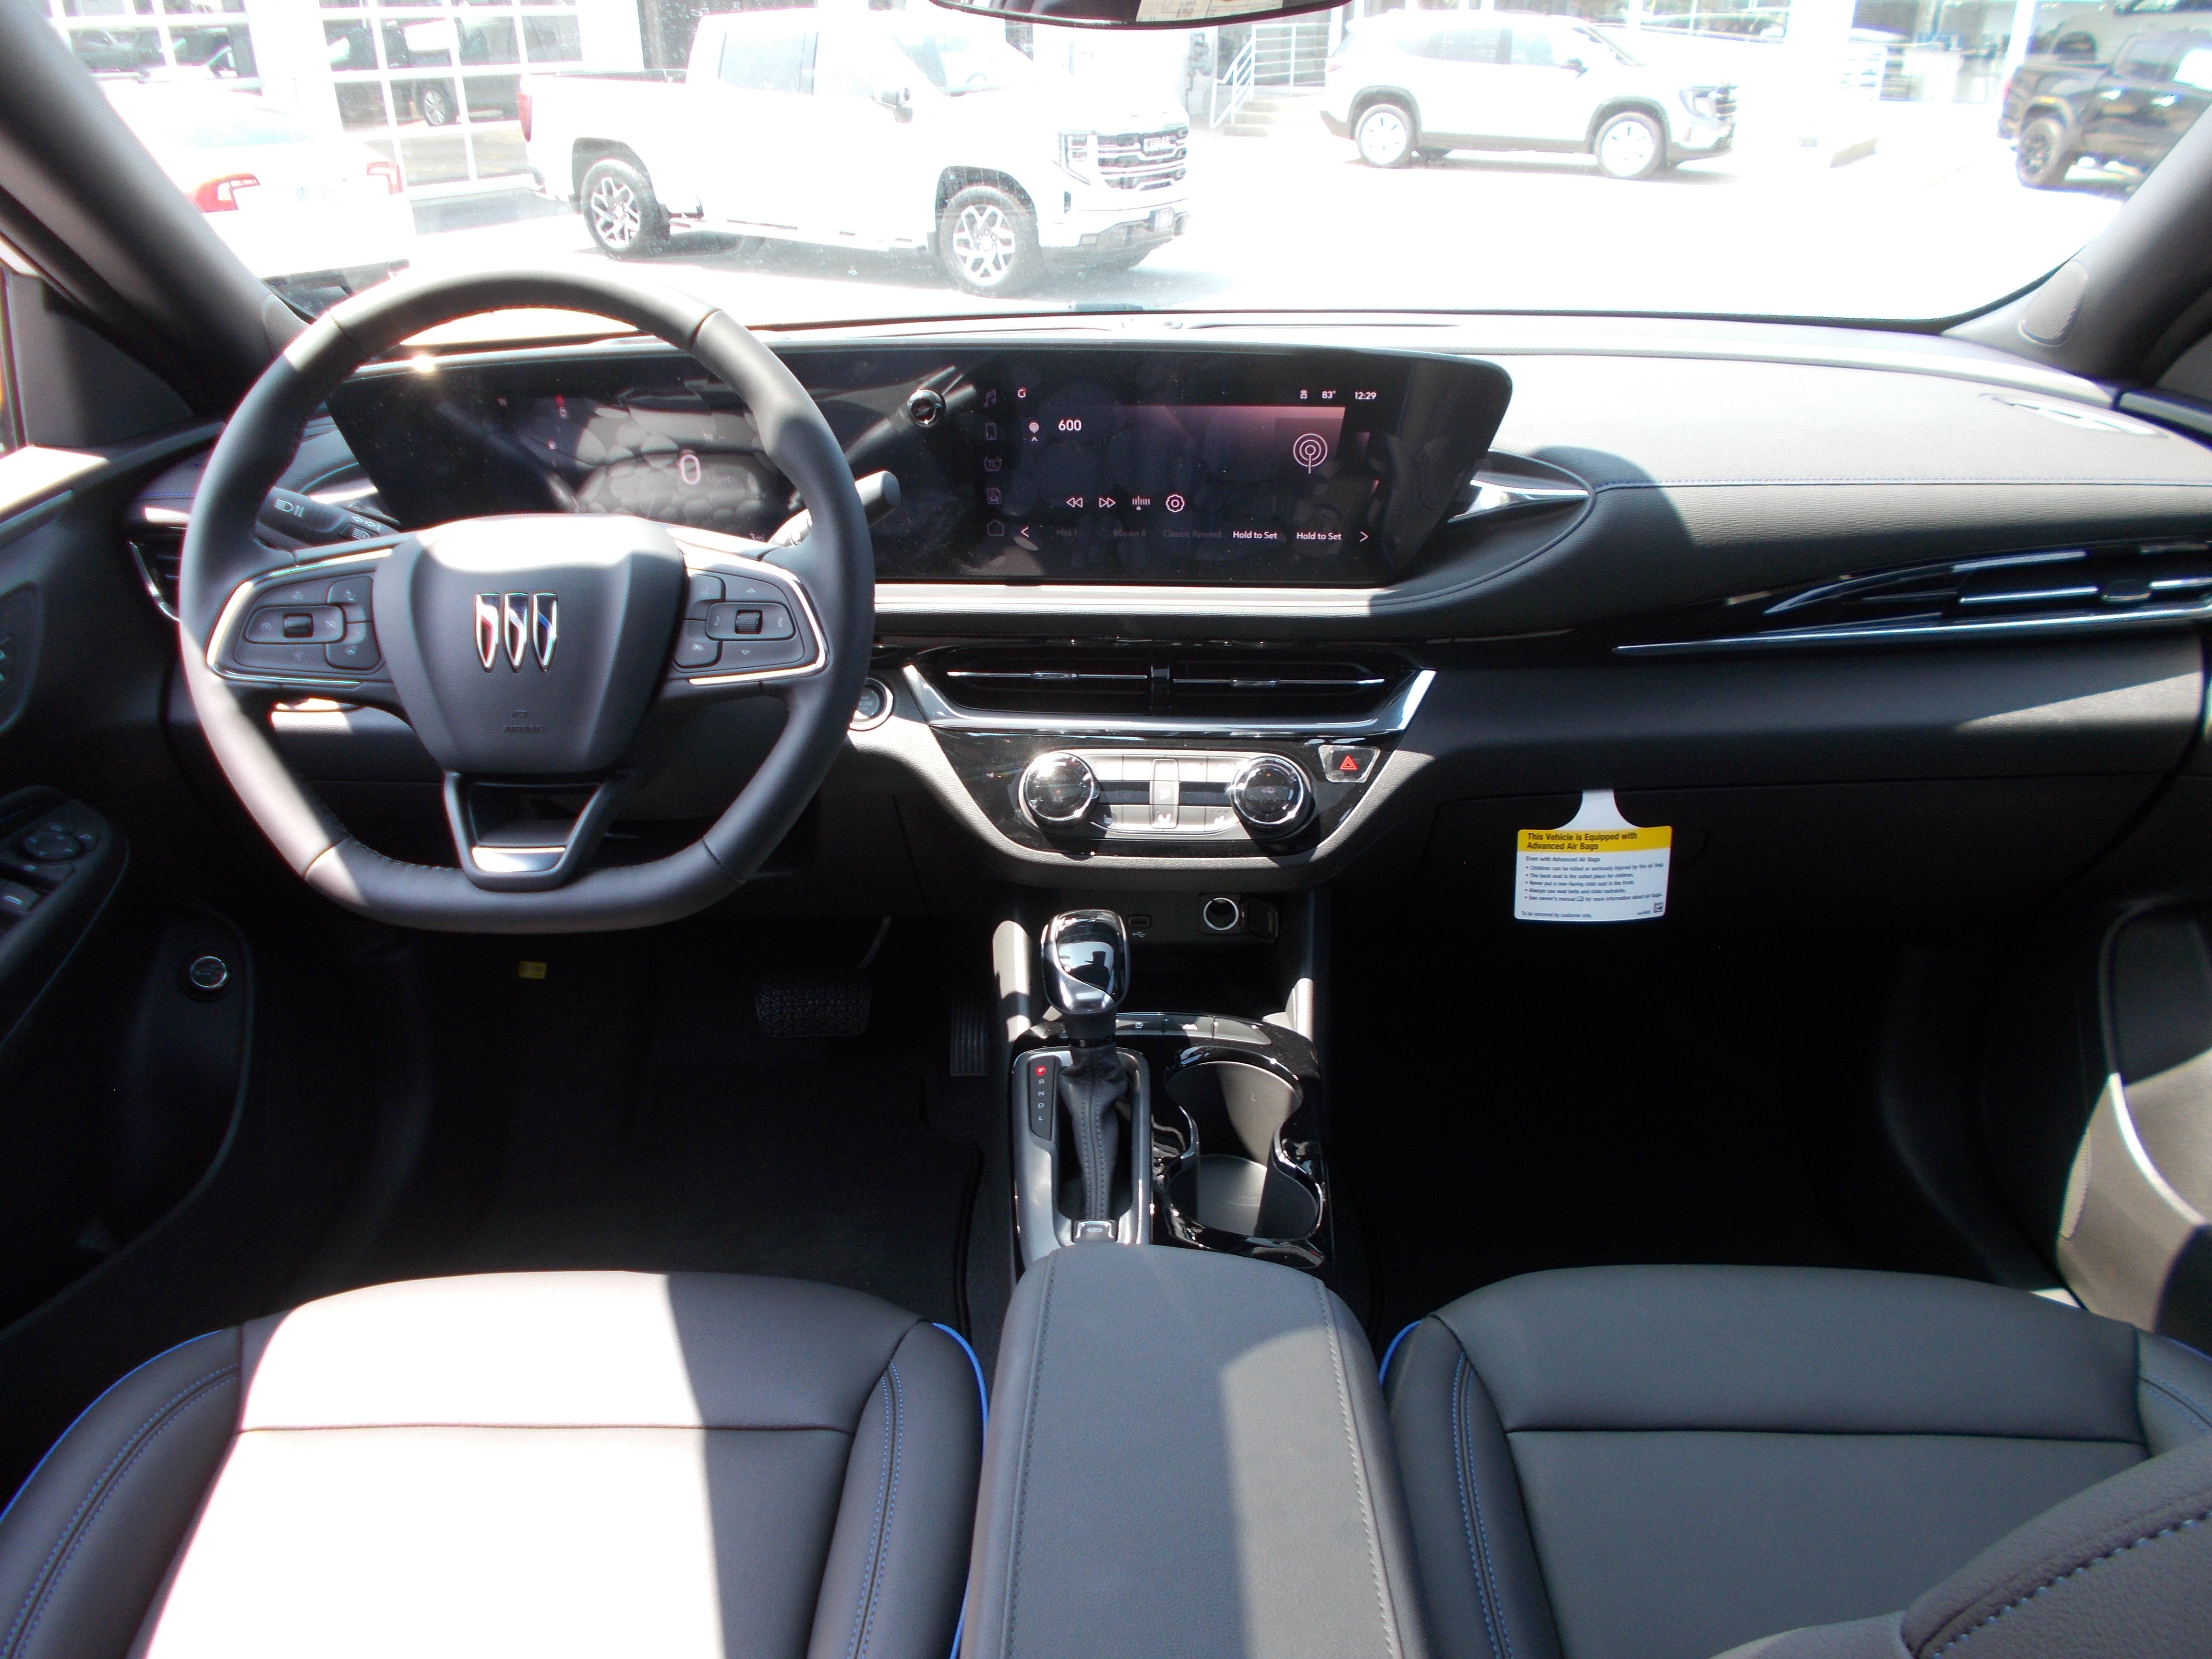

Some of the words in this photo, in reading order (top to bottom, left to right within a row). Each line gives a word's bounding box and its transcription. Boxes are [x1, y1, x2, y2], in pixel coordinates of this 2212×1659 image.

[1354, 391, 1377, 400] 12:29
[1058, 420, 1082, 432] 600
[680, 454, 701, 485] 0
[1585, 833, 1619, 842] Equipped
